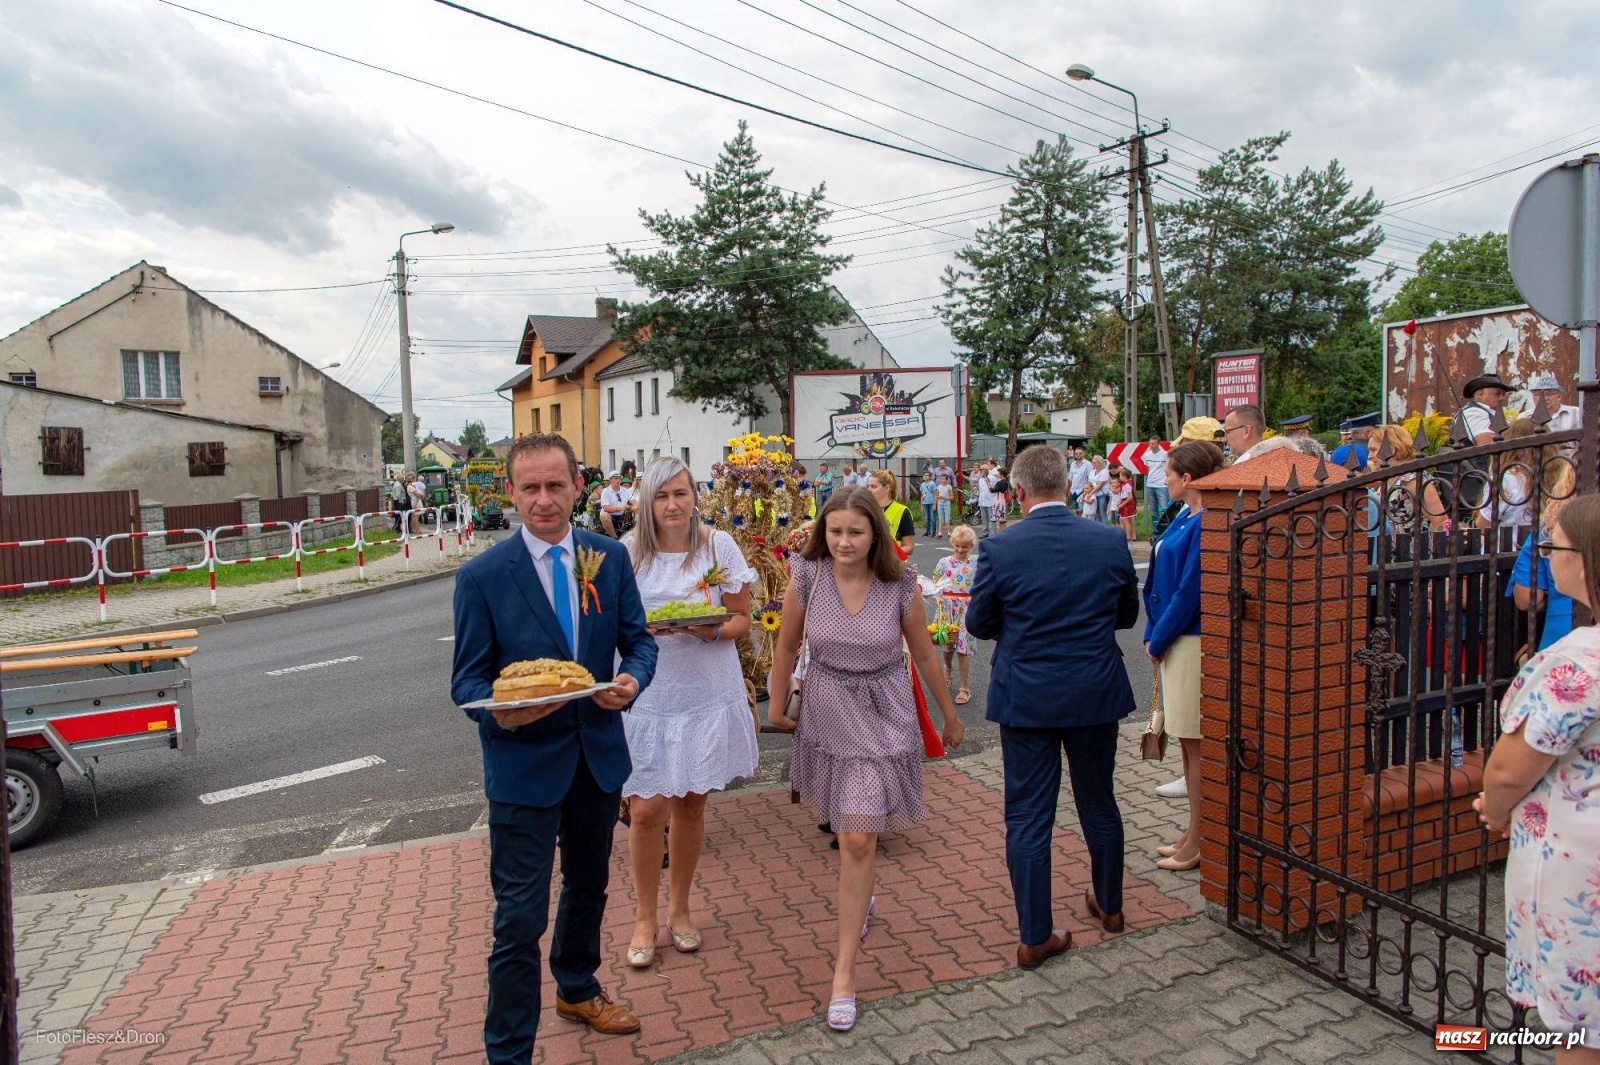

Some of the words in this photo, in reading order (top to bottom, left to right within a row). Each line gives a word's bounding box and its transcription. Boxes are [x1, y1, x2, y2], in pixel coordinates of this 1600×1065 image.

[1219, 359, 1256, 368] HUNTER
[1217, 374, 1256, 385] KOMPUTEROWA
[1217, 385, 1245, 394] GEOMETRIA
[834, 416, 866, 424] RADIO
[835, 416, 920, 433] VANESSA
